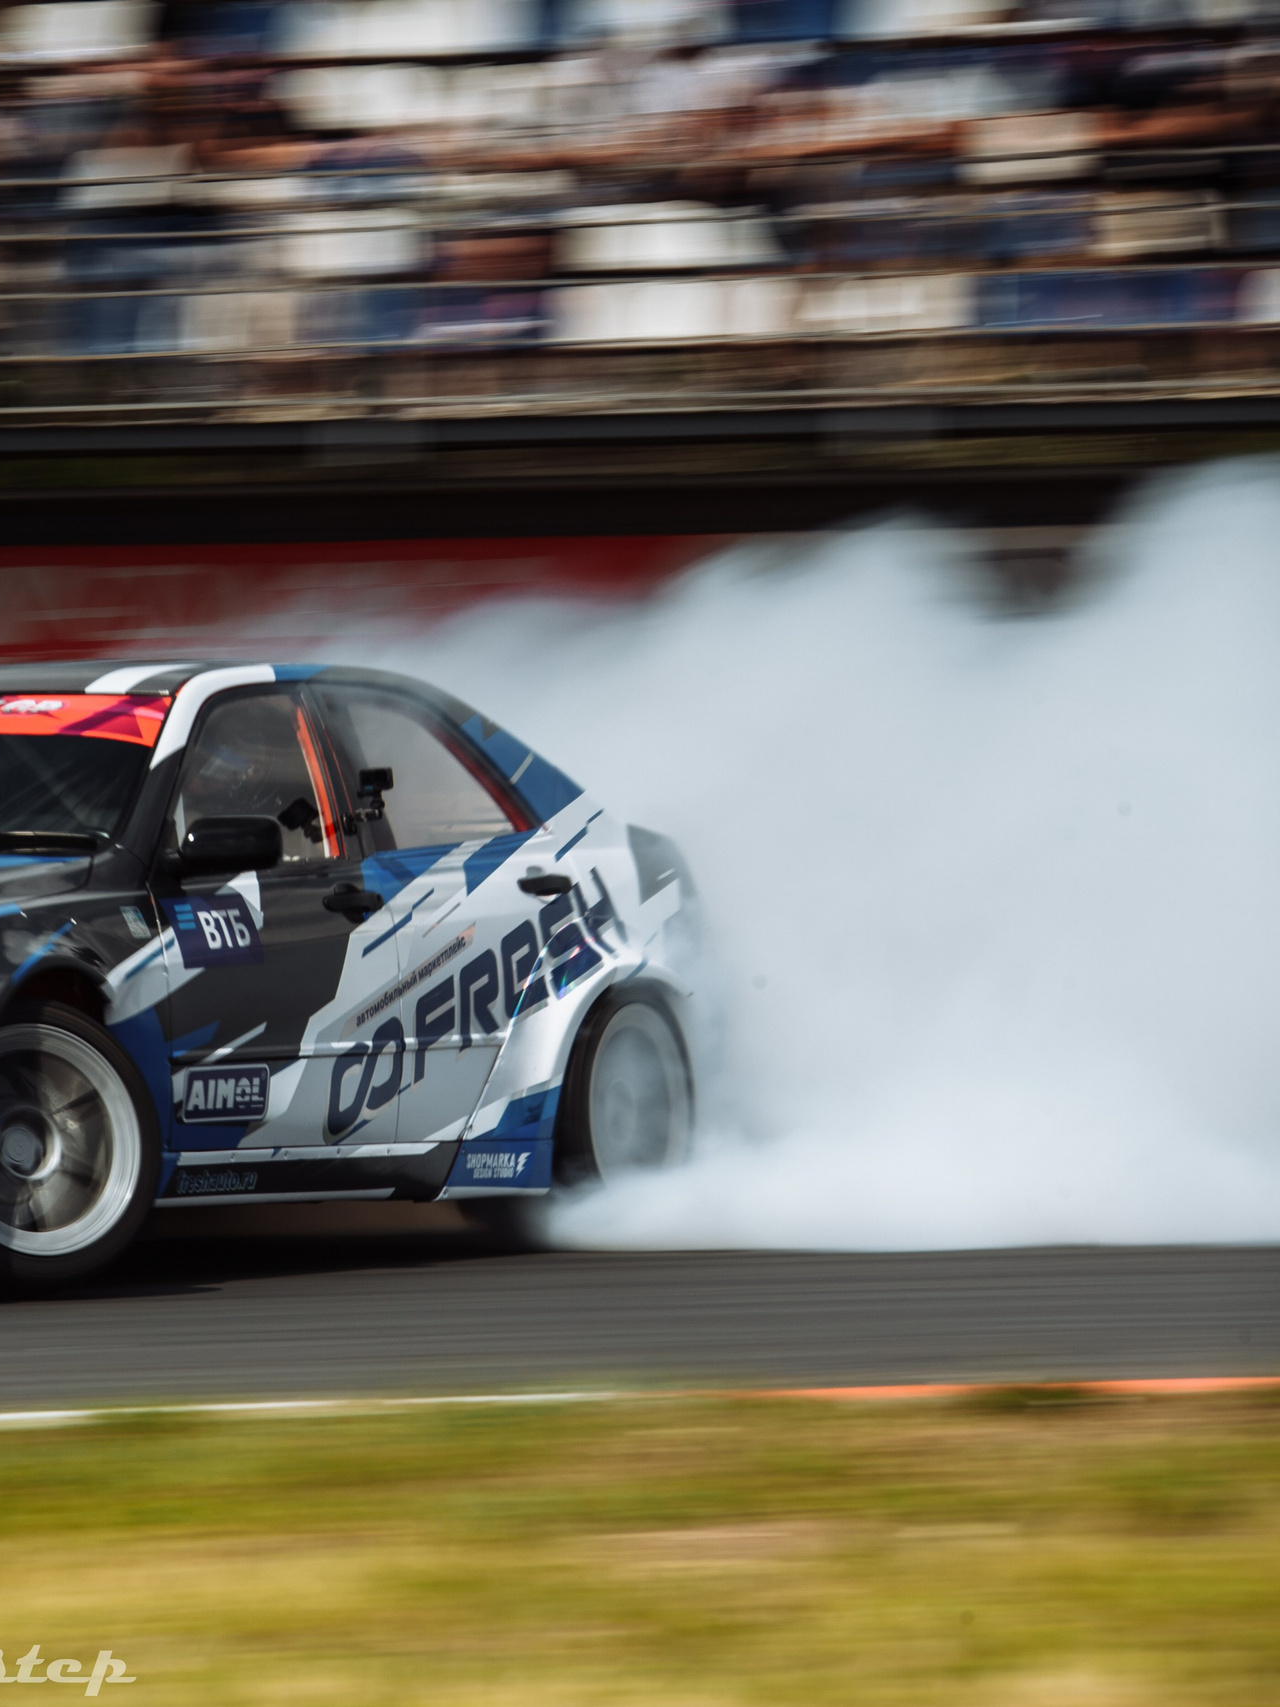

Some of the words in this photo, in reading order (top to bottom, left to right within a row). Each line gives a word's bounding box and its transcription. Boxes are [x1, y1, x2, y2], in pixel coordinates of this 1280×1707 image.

[196, 907, 252, 950] ВТБ
[356, 969, 419, 1028] автомобильный
[417, 936, 467, 983] маркетплейс
[466, 1152, 516, 1169] SHOPMARKA
